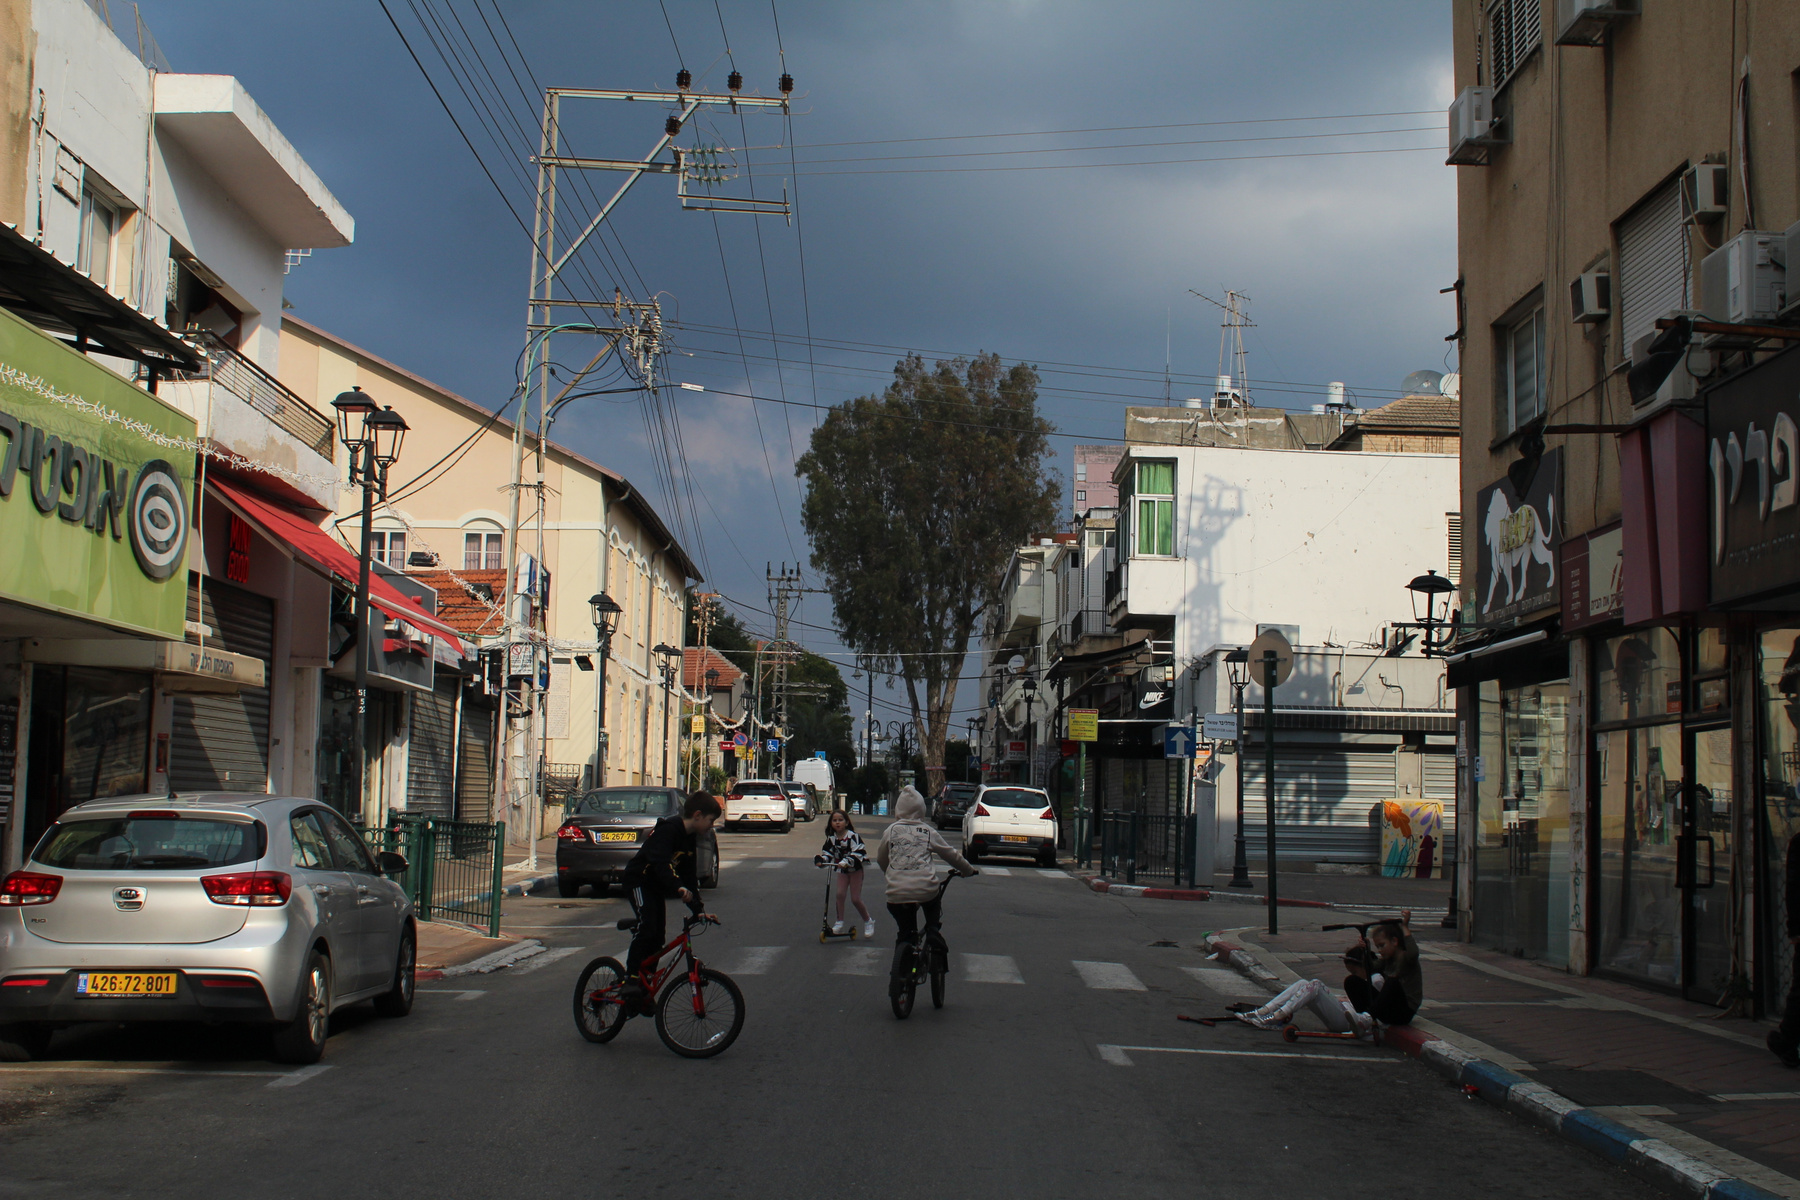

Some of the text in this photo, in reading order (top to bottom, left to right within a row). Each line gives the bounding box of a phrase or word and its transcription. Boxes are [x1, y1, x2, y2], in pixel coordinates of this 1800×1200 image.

[1499, 505, 1535, 553] LEO
[1143, 691, 1165, 702] NIKE
[120, 890, 137, 898] KIA
